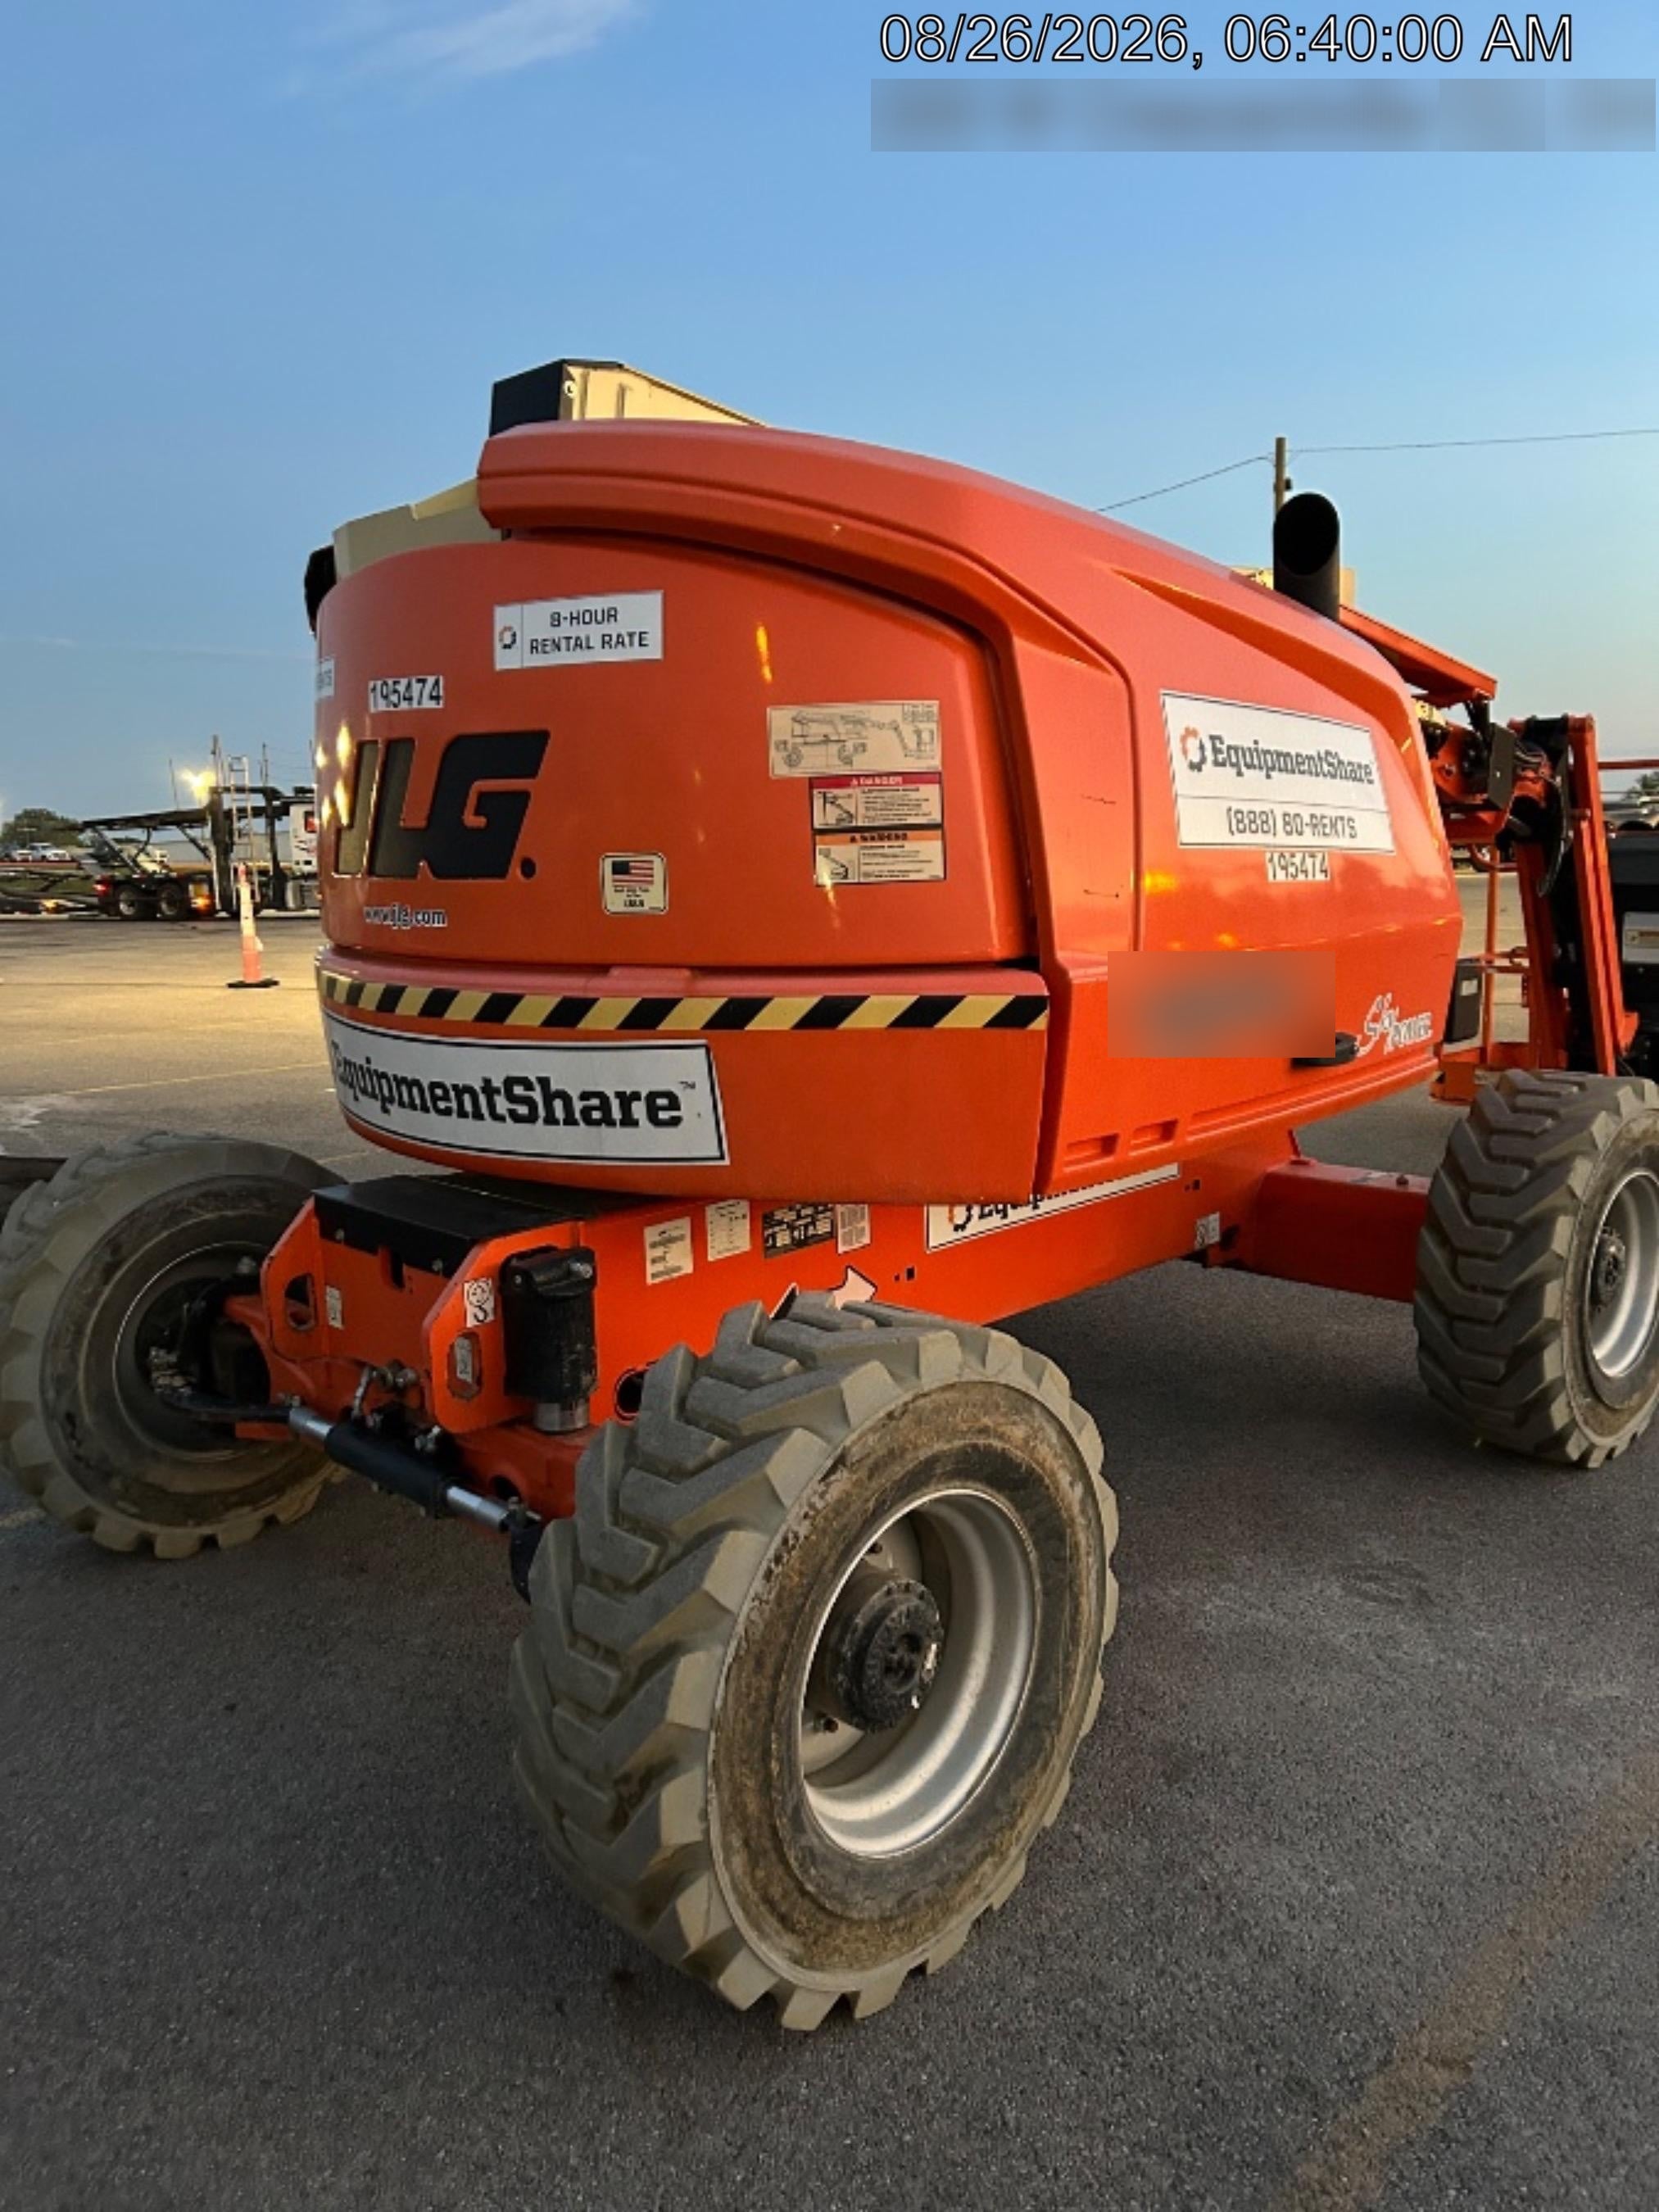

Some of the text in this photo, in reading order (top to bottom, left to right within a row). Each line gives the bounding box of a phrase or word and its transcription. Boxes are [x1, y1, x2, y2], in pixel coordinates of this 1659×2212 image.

[550, 606, 619, 628] 8-HOUR
[530, 631, 650, 655] RENTAL RATE
[370, 676, 443, 710] 195474
[1208, 733, 1376, 785] EquipmentShare
[1226, 805, 1277, 837] (888)
[1267, 851, 1329, 881] 195474
